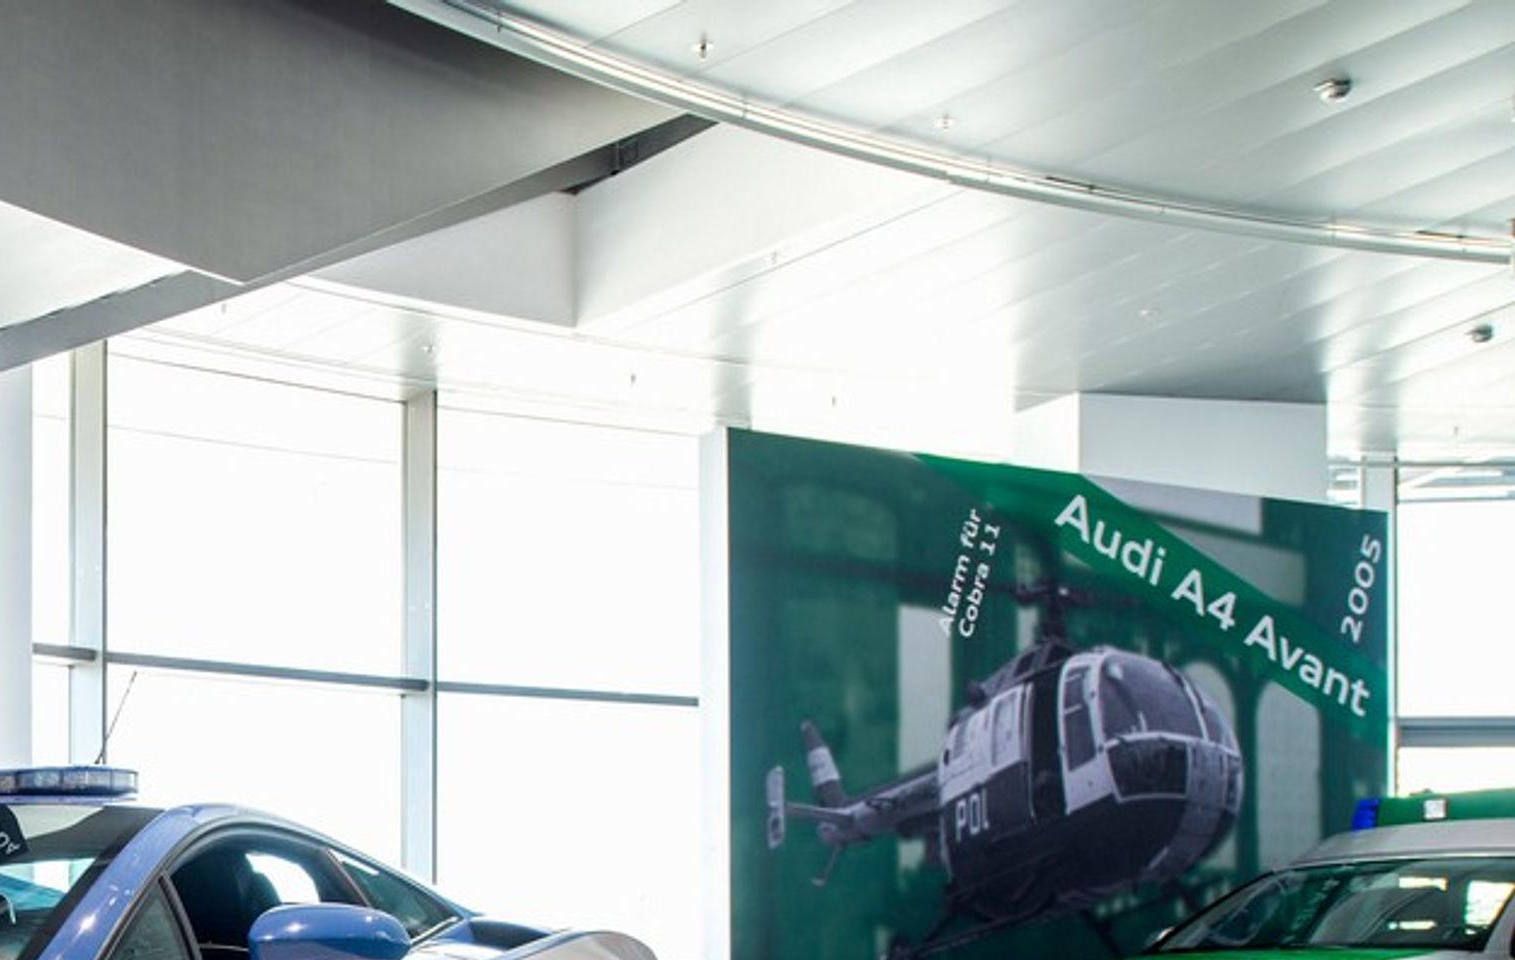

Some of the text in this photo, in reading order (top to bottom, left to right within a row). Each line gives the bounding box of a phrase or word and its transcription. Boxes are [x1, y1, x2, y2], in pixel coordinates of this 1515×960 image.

[938, 508, 981, 637] Alarm für
[958, 562, 990, 637] Cobra
[1054, 494, 1371, 717] Audi A4 Avant
[1340, 534, 1382, 644] 2005
